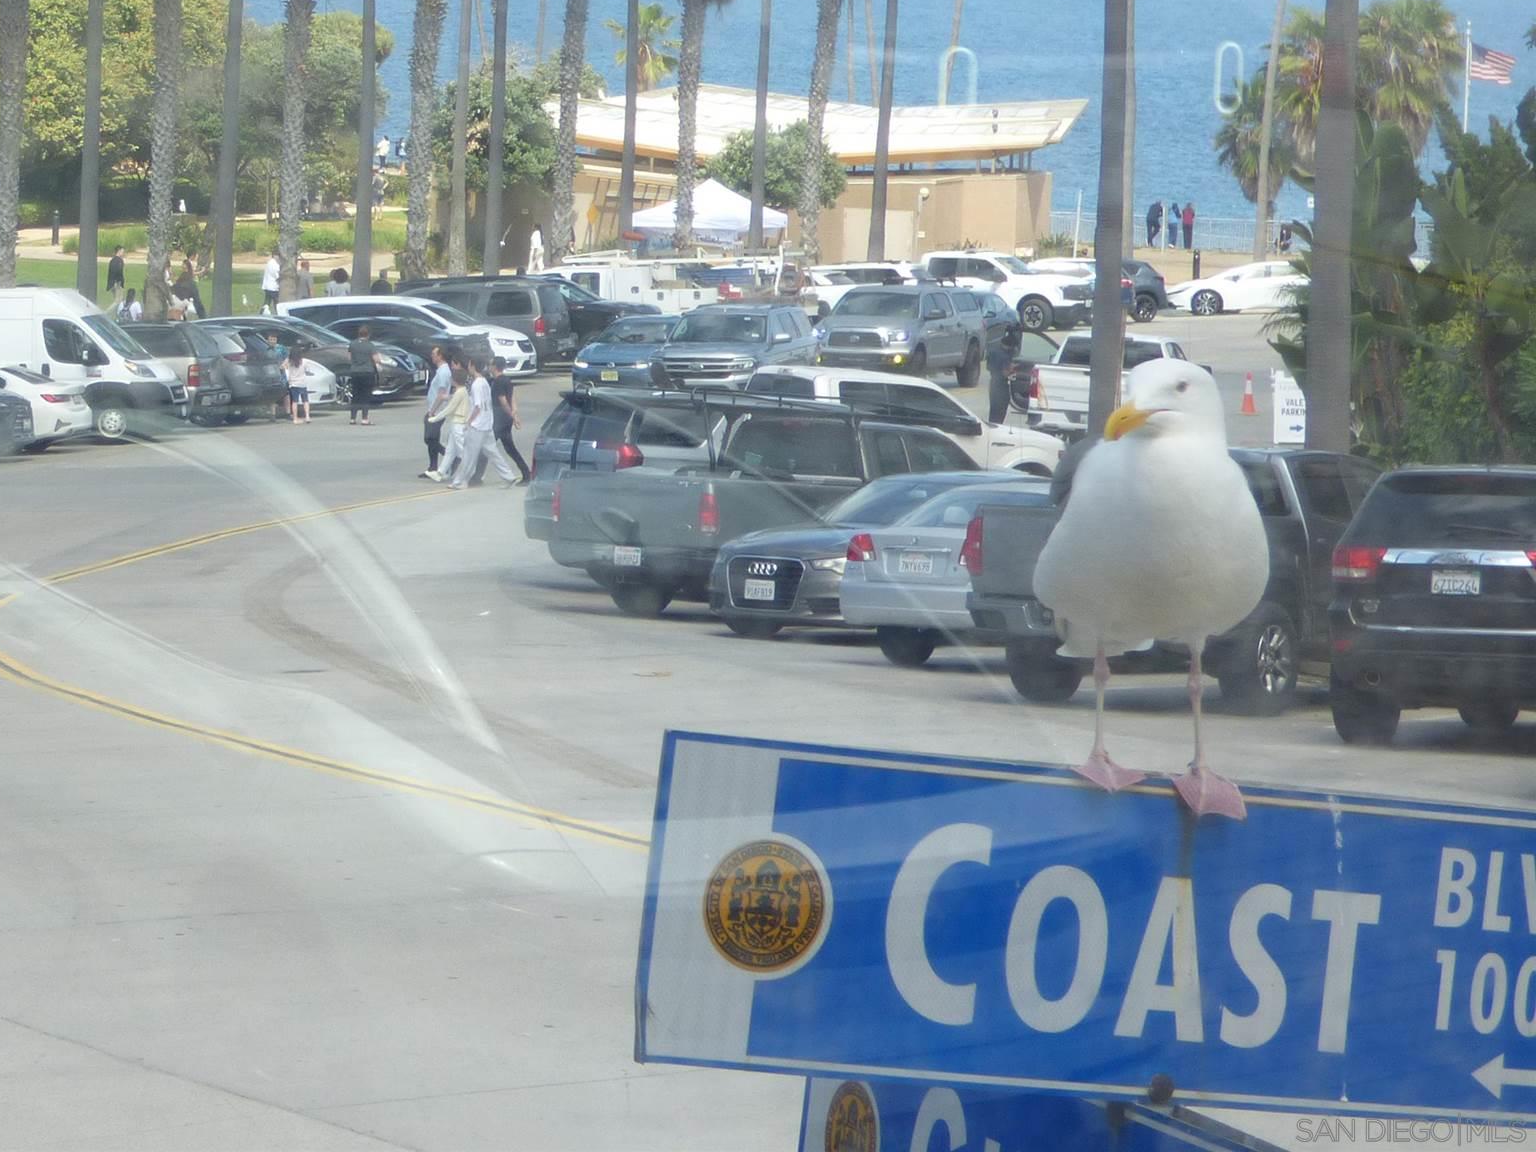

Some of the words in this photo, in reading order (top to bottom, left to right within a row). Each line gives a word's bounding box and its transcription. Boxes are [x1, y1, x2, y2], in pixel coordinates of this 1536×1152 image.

[1285, 398, 1305, 406] VALE
[1281, 408, 1305, 416] PARKI
[886, 822, 1382, 1055] COAST
